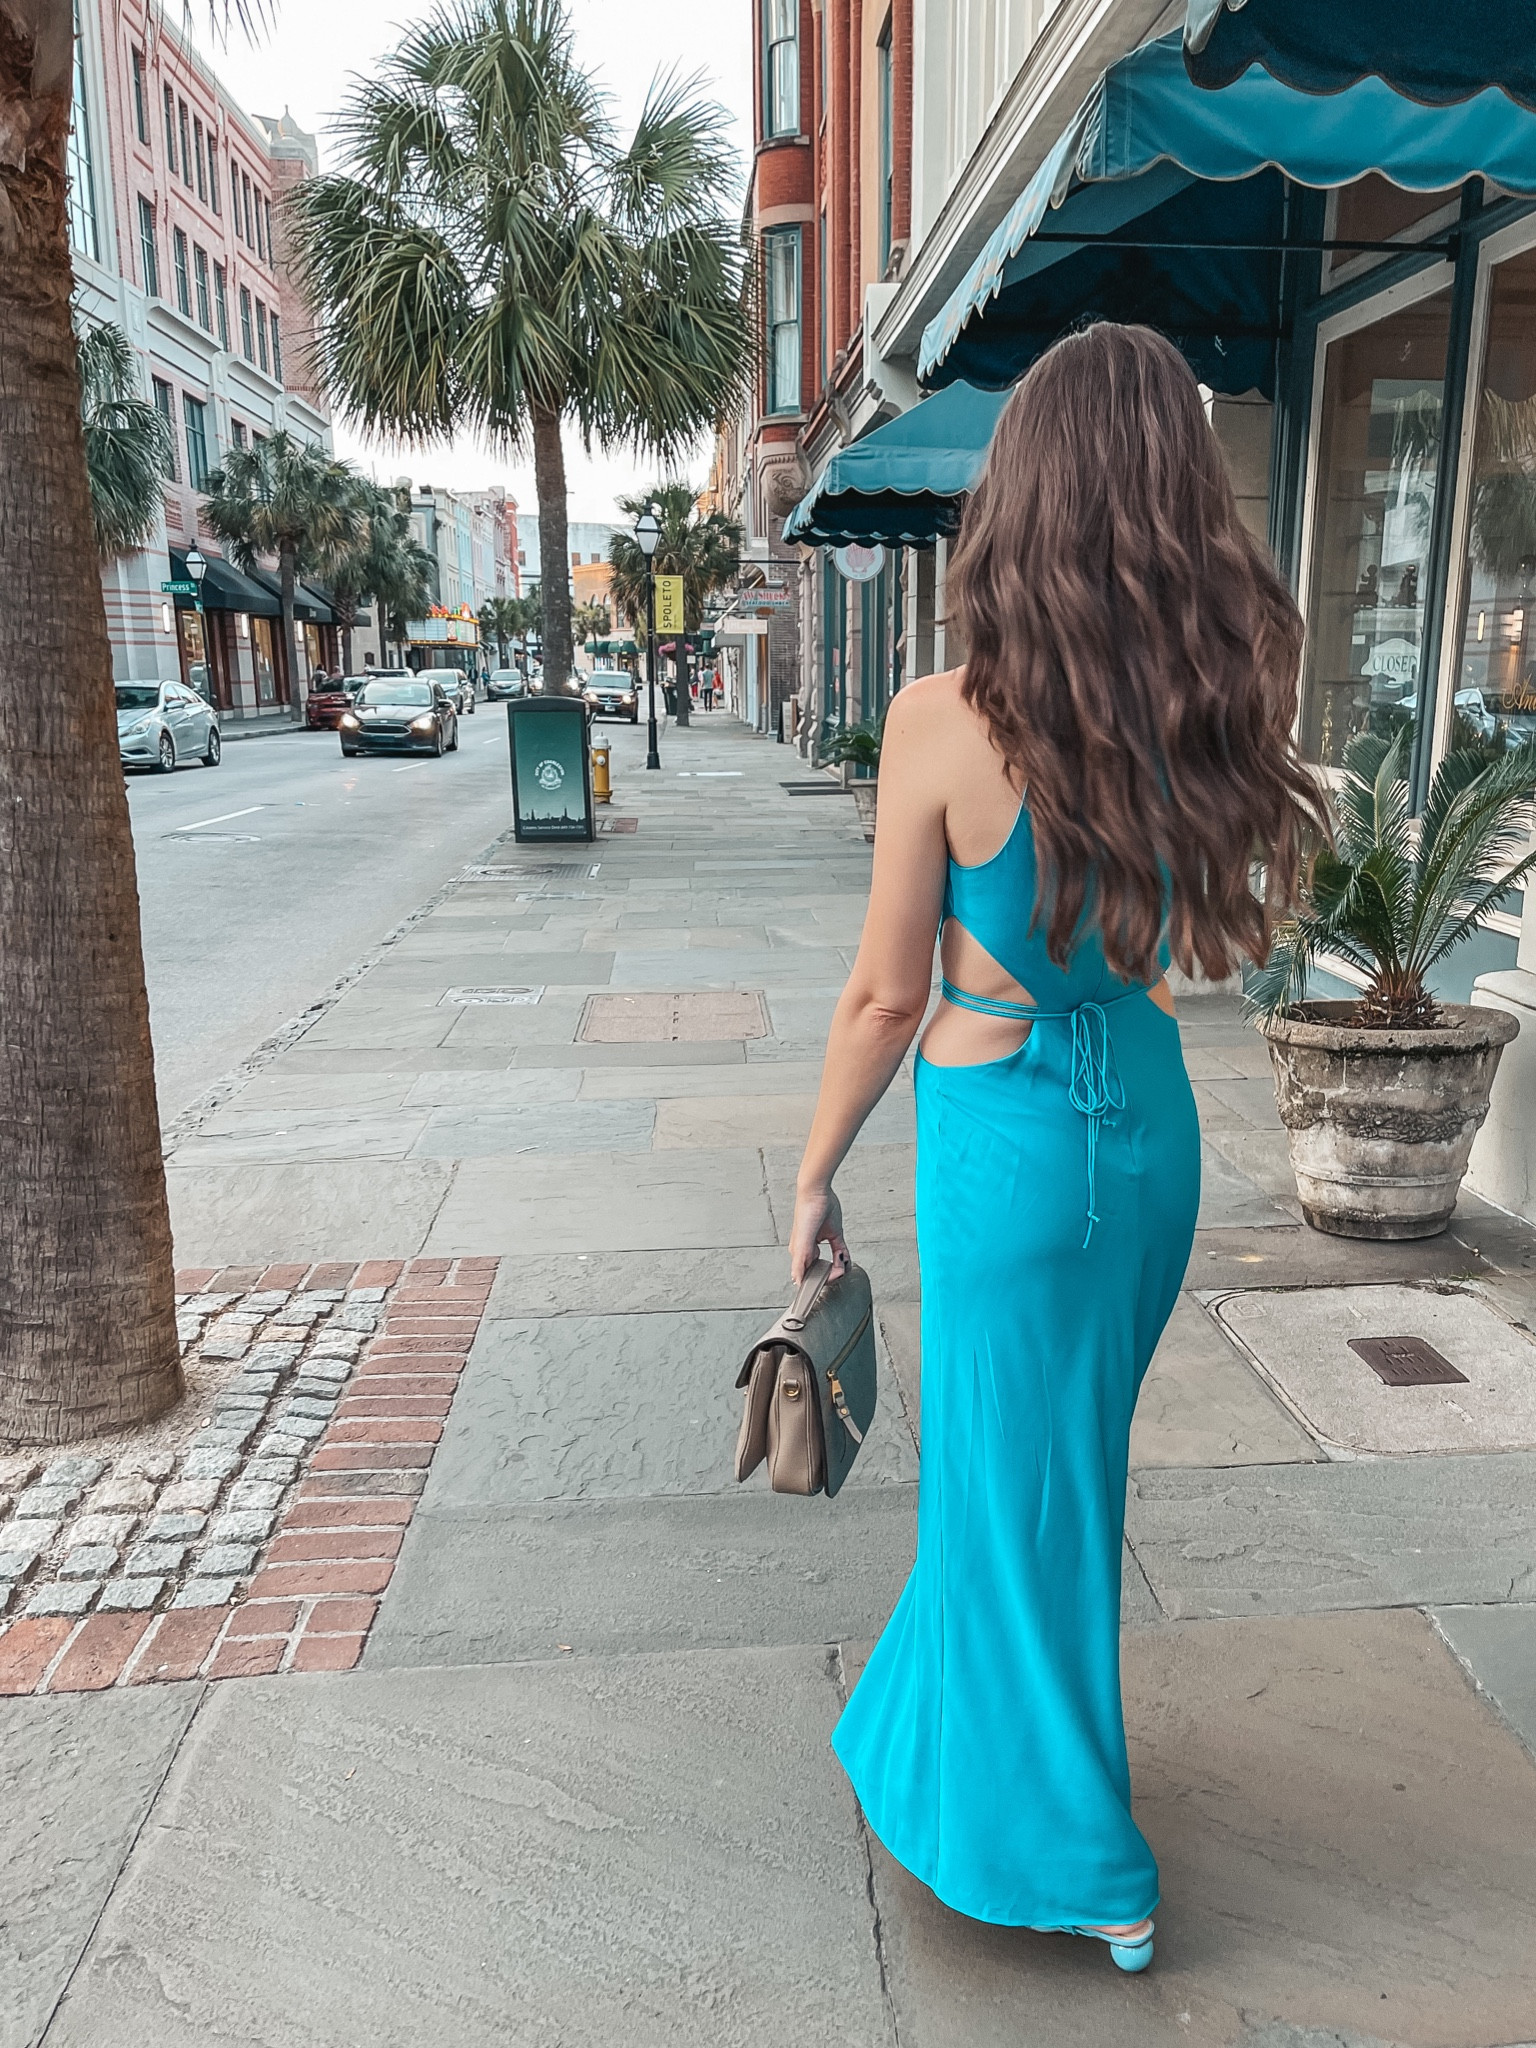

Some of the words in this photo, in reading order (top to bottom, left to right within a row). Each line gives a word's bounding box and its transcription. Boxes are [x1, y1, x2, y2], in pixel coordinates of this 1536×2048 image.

[162, 582, 190, 591] Princess
[662, 580, 672, 629] SPOLETO
[1373, 655, 1418, 673] CLOSED
